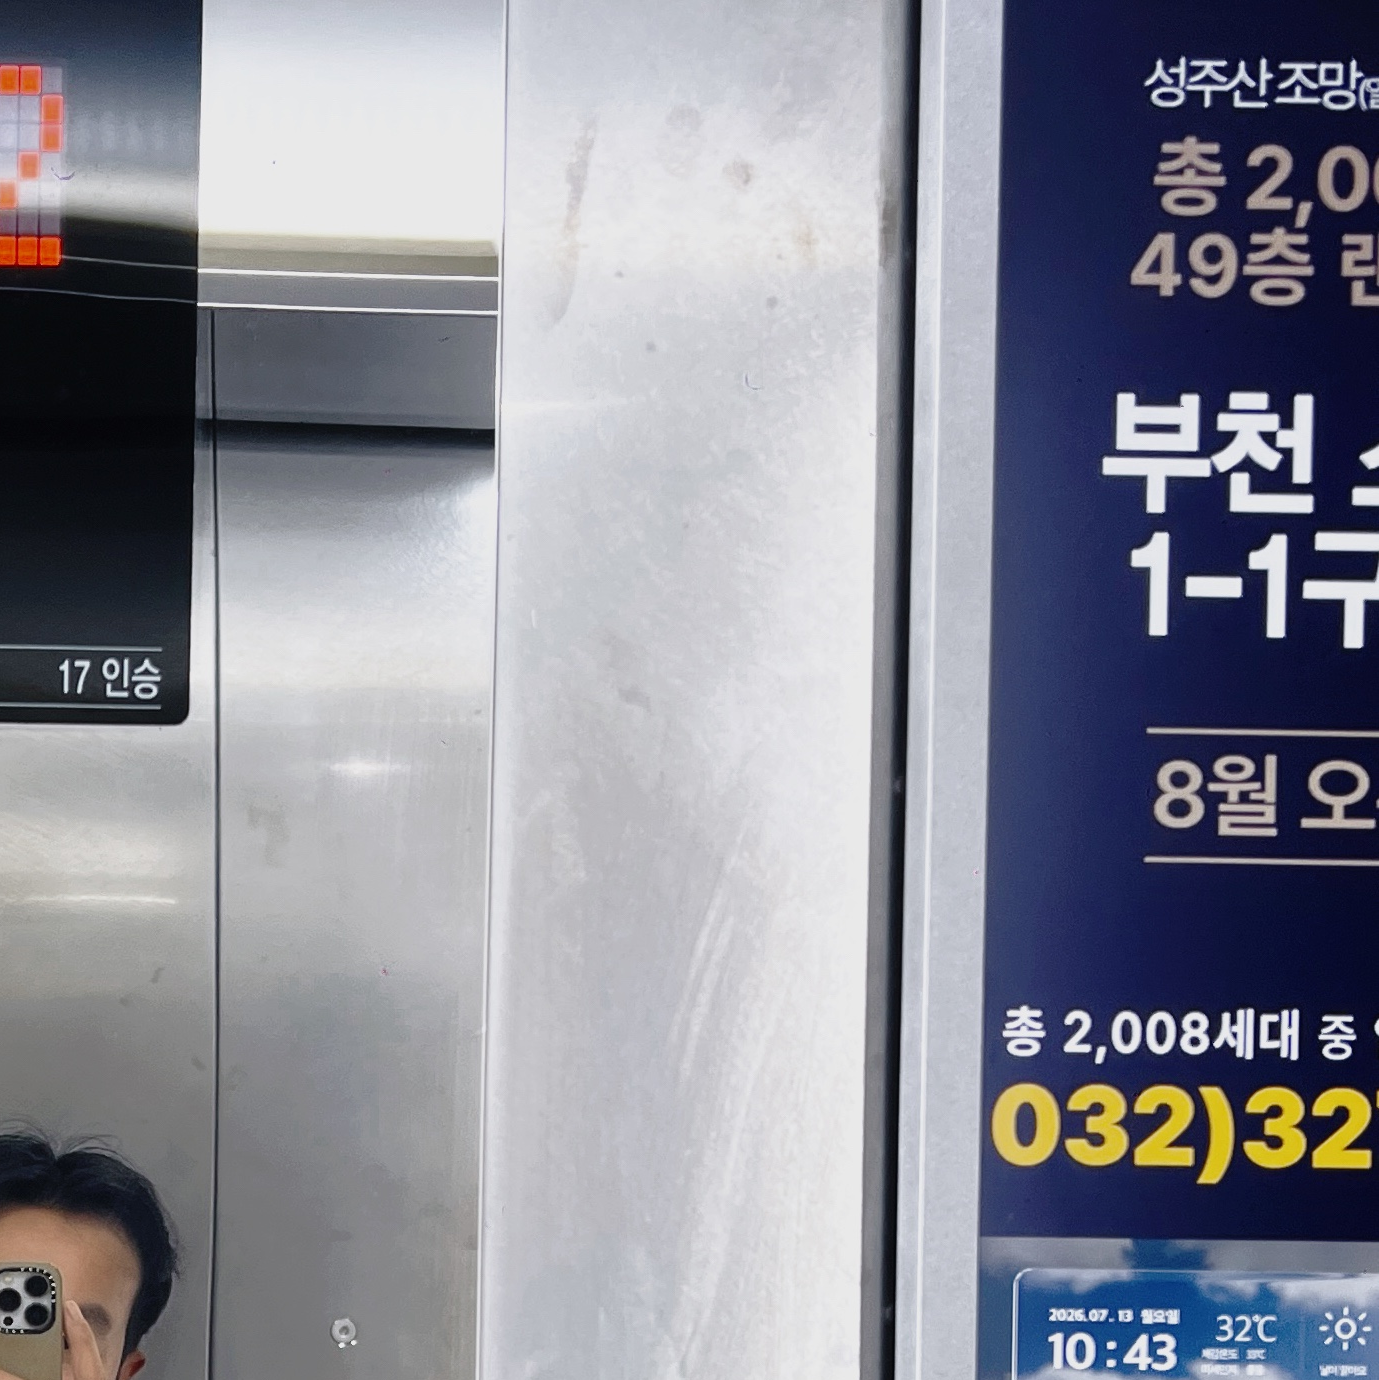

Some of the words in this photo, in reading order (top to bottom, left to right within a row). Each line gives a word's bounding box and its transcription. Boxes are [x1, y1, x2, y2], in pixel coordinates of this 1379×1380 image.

[1144, 56, 1273, 108] 성주산
[1153, 136, 1227, 216] 총
[1246, 144, 1379, 228] 2,0
[1130, 226, 1315, 306] 49층
[1102, 391, 1314, 514] 부천
[59, 659, 91, 694] 17
[102, 657, 162, 699] 인승
[1154, 754, 1278, 837] 8월
[1300, 759, 1379, 829] 오
[1002, 1005, 1046, 1057] 총
[1063, 1008, 1299, 1064] 2,008세대
[1318, 1015, 1357, 1060] 중
[991, 1083, 1379, 1184] 032)32
[1140, 1308, 1180, 1324] 월요일
[1047, 1331, 1178, 1371] 10:43
